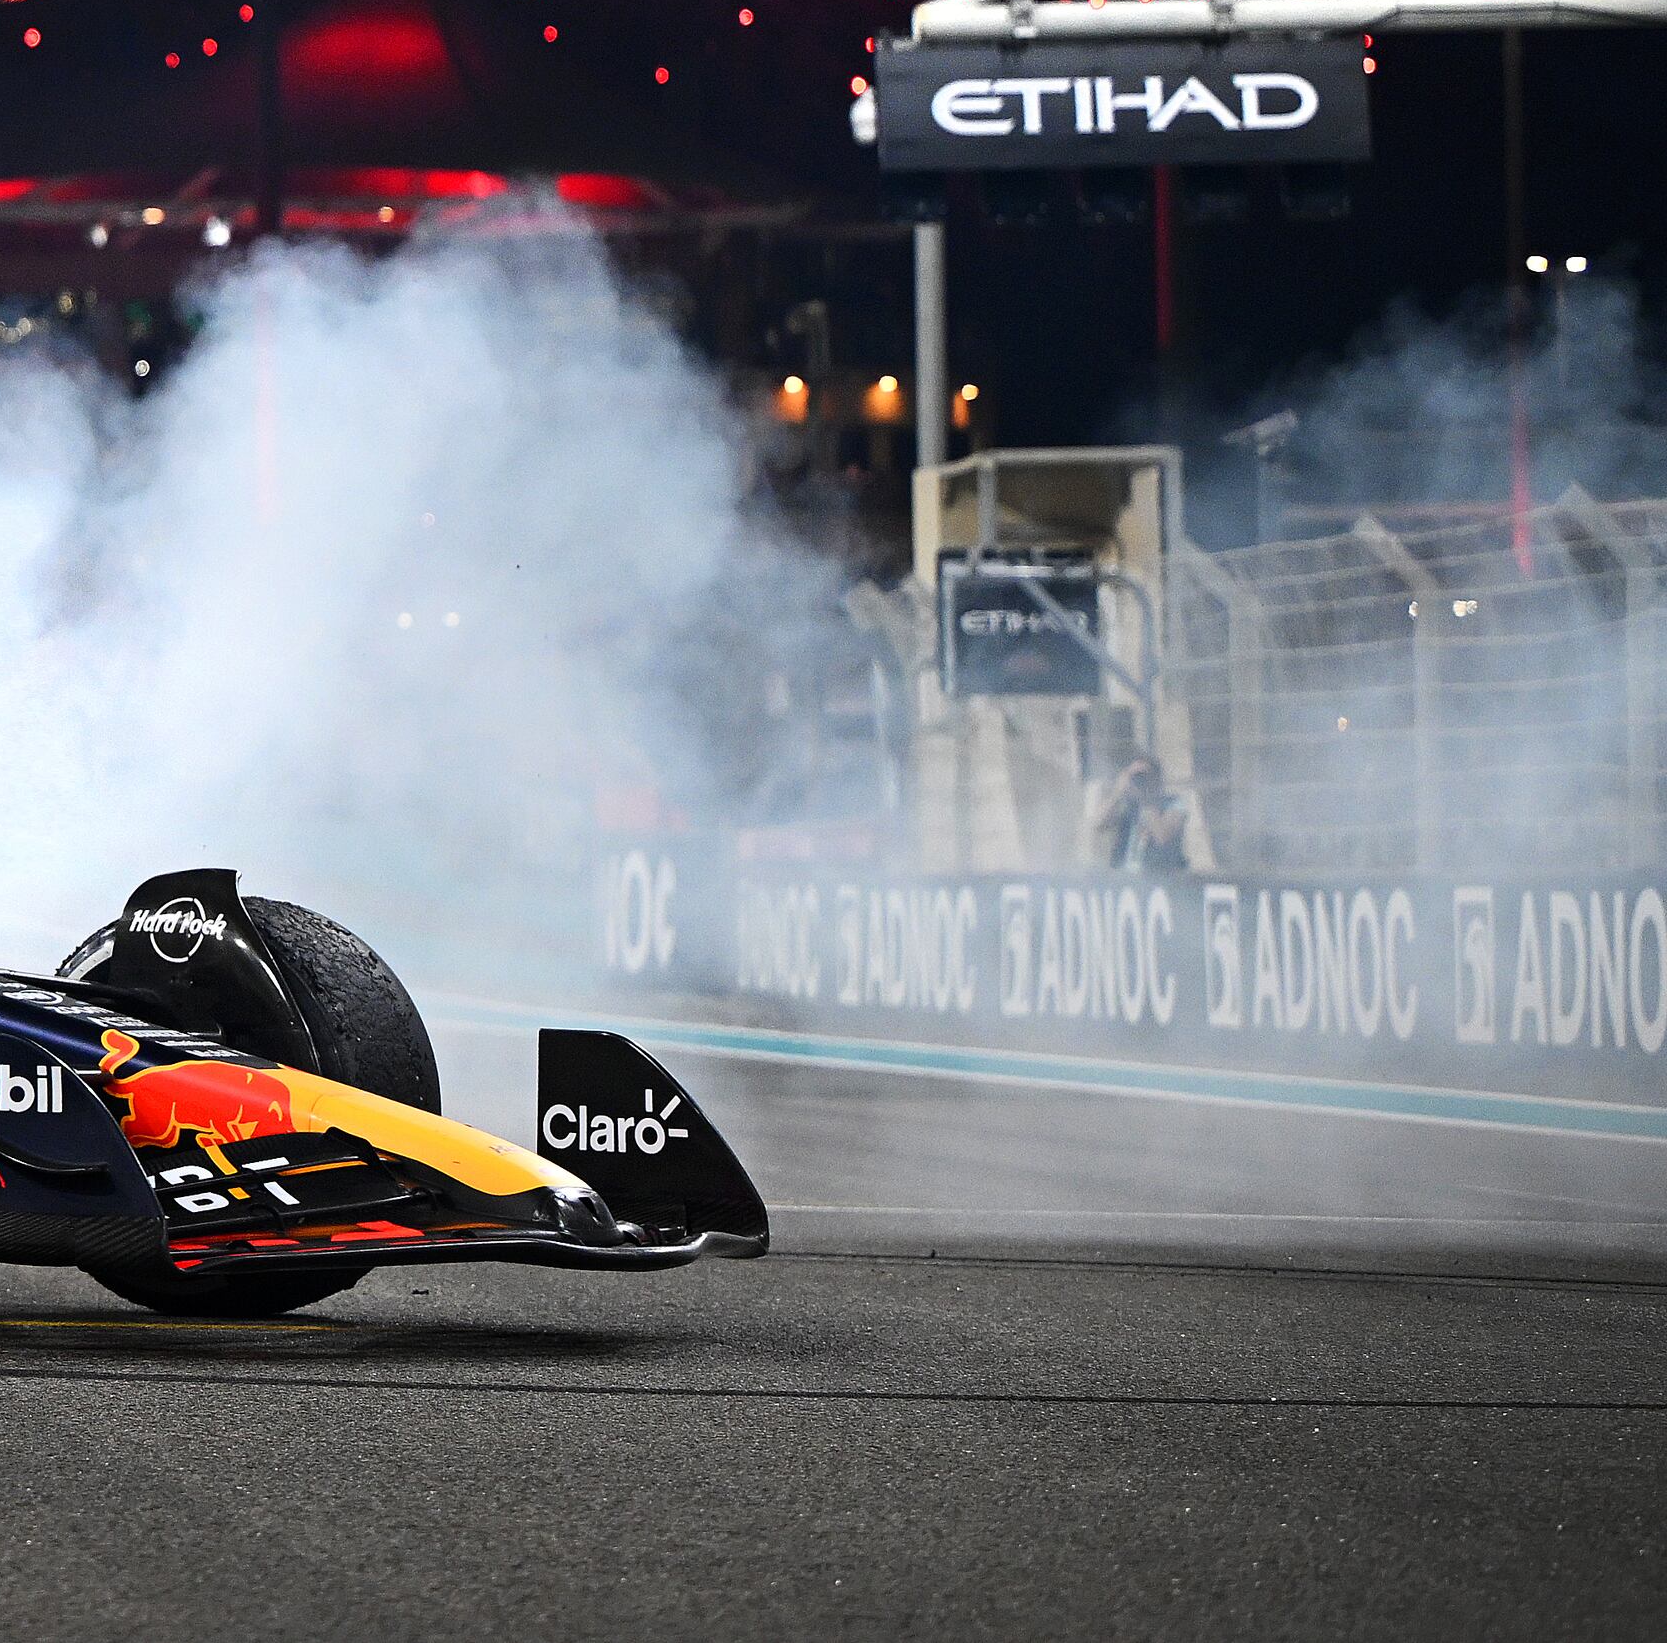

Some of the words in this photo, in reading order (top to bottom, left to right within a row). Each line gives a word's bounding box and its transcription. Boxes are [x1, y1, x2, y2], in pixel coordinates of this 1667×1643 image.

[930, 72, 1319, 137] ETIHAD
[129, 909, 182, 933] Hard
[1037, 887, 1177, 1027] ADNOC
[1254, 888, 1417, 1040] ADNOC
[542, 1103, 666, 1155] Claro
